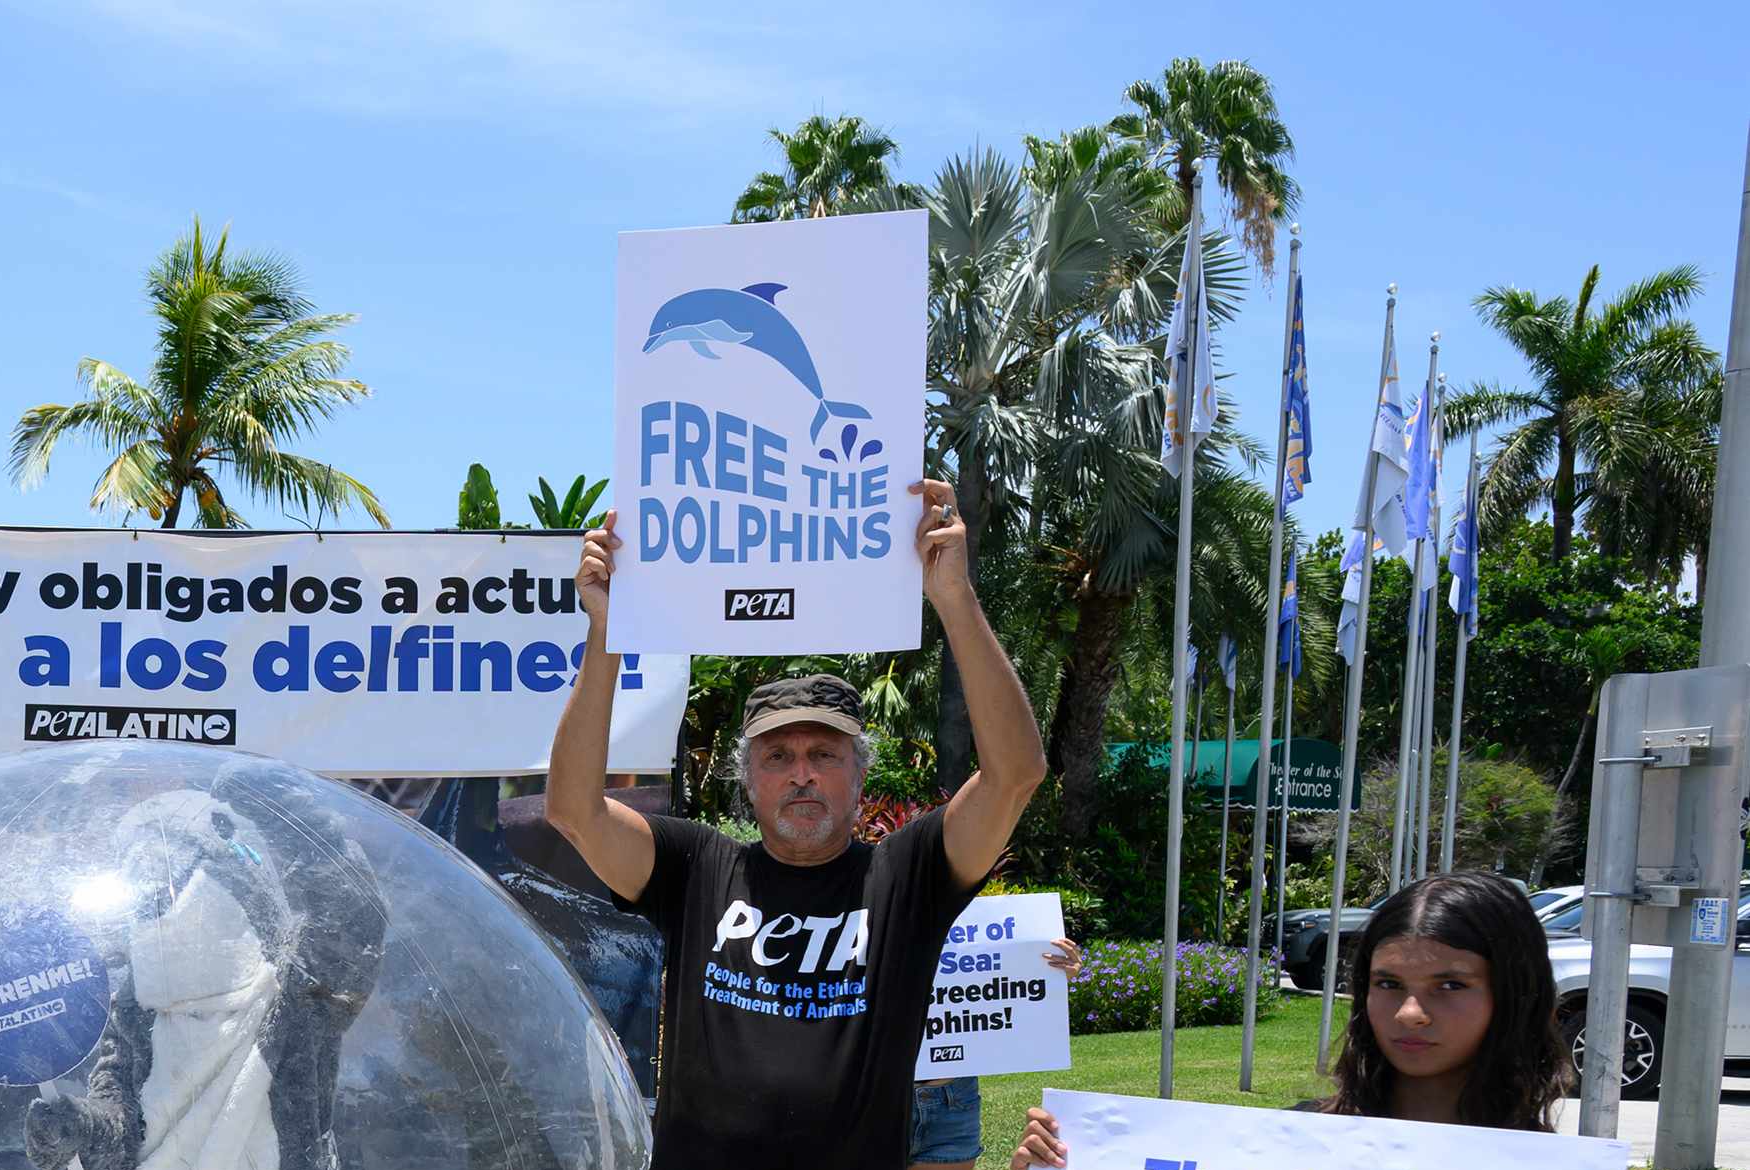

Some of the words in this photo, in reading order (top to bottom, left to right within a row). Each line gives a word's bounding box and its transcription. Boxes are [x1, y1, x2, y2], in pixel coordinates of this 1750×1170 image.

[641, 401, 787, 502] FREE
[802, 465, 888, 509] THE
[640, 497, 891, 563] DOLPHINS
[39, 561, 363, 622] obligados
[382, 577, 418, 614] a
[436, 569, 588, 614] actu
[19, 635, 70, 686] a
[100, 622, 227, 691] los
[986, 917, 1015, 941] of
[705, 962, 751, 990] People
[755, 976, 781, 996] for
[785, 982, 813, 999] the
[818, 976, 866, 999] Ethical
[940, 951, 1001, 974] Sea:
[703, 981, 780, 1016] Treatment
[784, 1003, 803, 1017] of
[807, 998, 866, 1019] Animals
